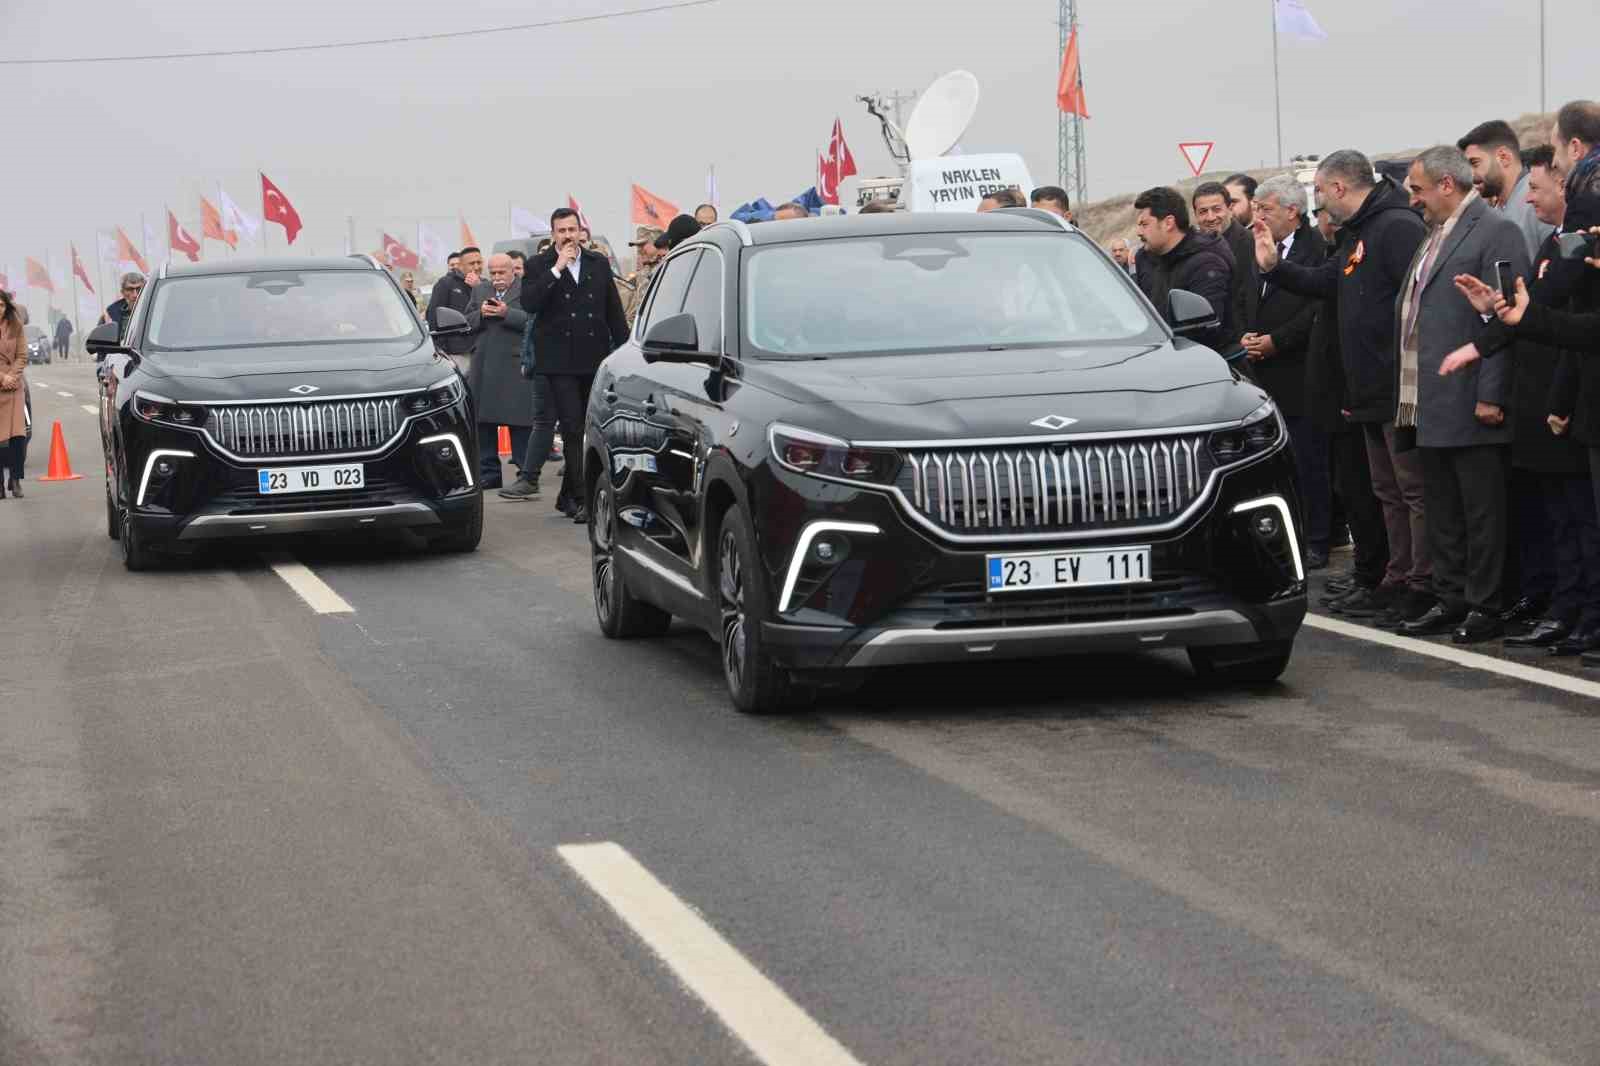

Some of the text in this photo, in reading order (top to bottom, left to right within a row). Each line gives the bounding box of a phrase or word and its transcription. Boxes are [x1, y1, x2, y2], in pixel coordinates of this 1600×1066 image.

[942, 168, 1001, 185] NAKLEN
[929, 185, 975, 203] YAYIN
[269, 473, 288, 489] 23
[301, 471, 320, 488] VD
[334, 469, 361, 486] 023
[1004, 552, 1144, 586] 23 EV 111
